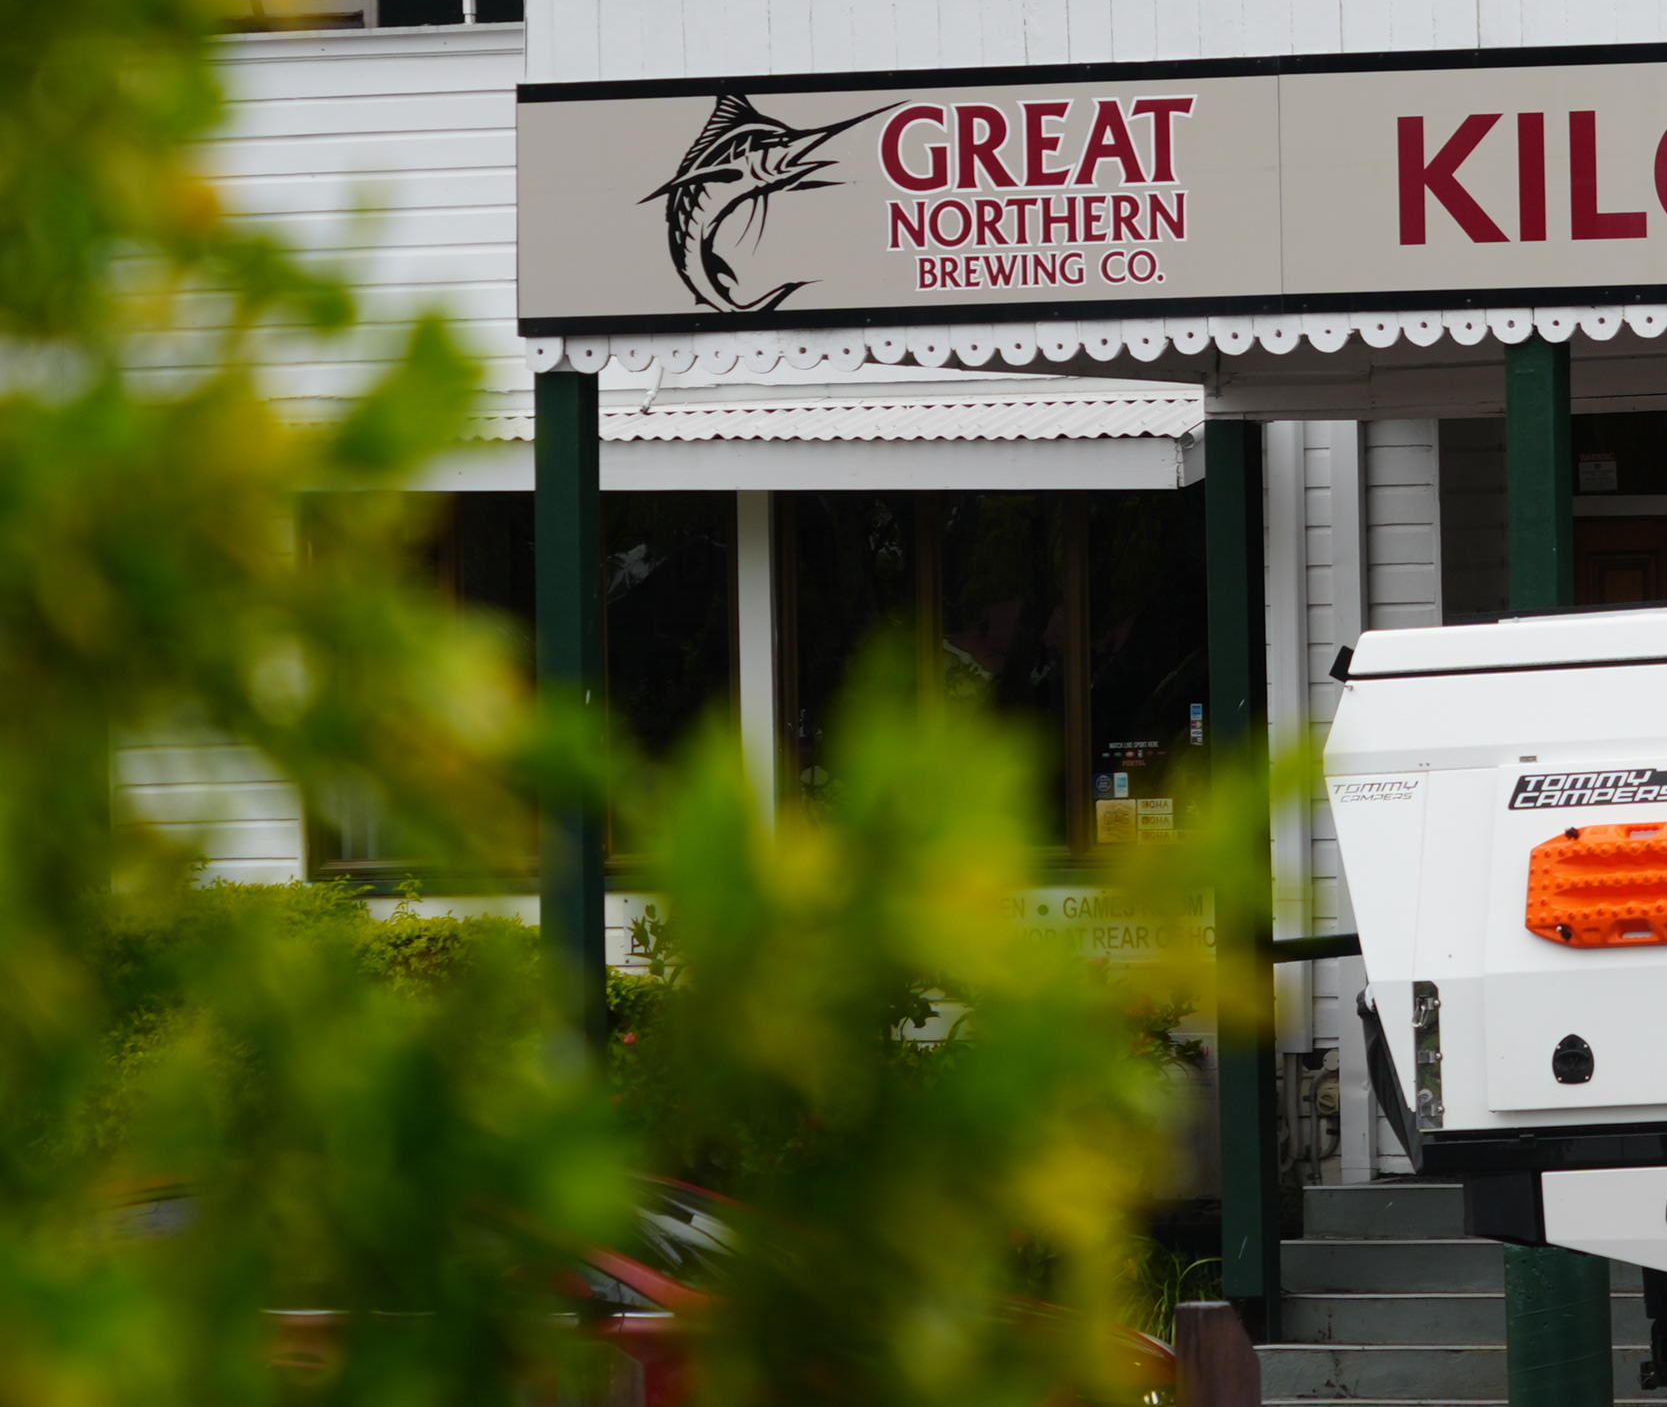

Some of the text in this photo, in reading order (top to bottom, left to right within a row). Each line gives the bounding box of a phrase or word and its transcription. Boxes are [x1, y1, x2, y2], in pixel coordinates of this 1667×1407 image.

[879, 94, 1198, 193] GREAT
[887, 191, 1188, 252] NORTHERN
[916, 249, 1165, 291] BREWING CO.
[1333, 780, 1418, 794] TOMMY
[1524, 770, 1653, 792] TOMMY
[1340, 792, 1413, 803] CAMPERS
[1093, 926, 1149, 950] REAR
